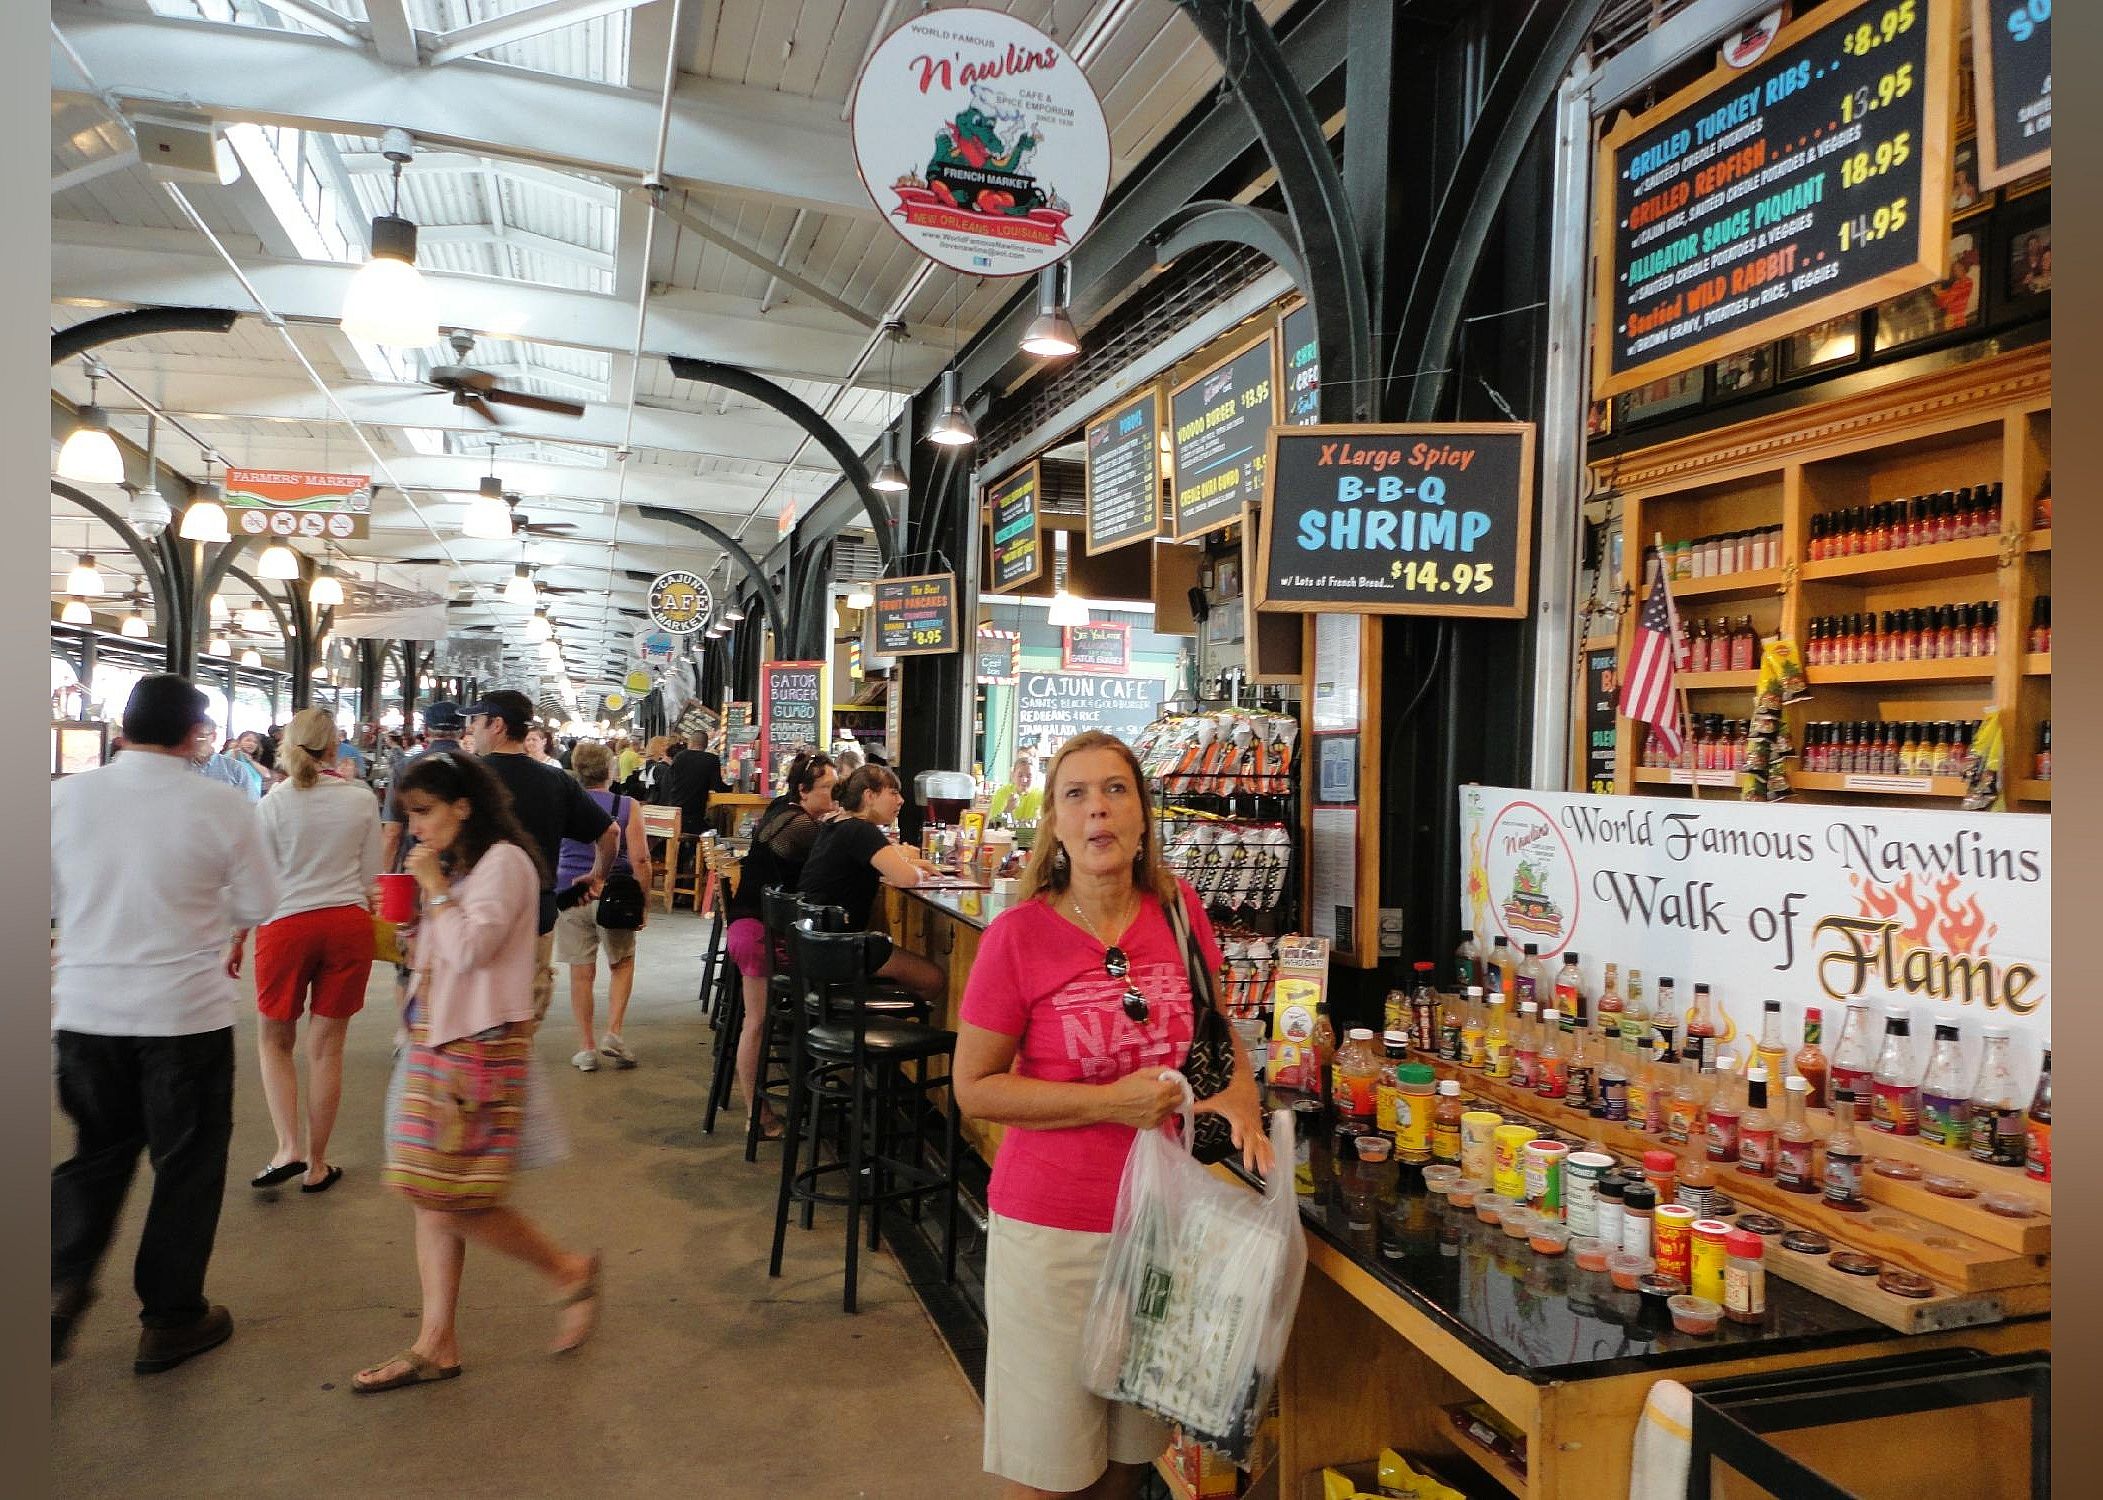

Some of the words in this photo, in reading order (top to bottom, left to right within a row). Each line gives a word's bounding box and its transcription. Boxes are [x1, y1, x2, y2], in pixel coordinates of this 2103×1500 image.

[911, 24, 950, 40] WORLD
[952, 32, 996, 48] FAMOUS
[1628, 127, 1692, 181] GRILLED
[1694, 86, 1761, 146] TURKEY
[1765, 58, 1811, 108] RIBS
[1842, 0, 1917, 58] $8.95
[1628, 180, 1691, 231] GRILLED
[1694, 137, 1767, 199] REDFISH
[1840, 62, 1913, 124] 13.95
[943, 166, 986, 184] FRENCH
[986, 174, 1030, 190] MARKET
[1628, 232, 1699, 288] ALLIGATOR
[1701, 207, 1751, 253] SAUCE
[1754, 171, 1826, 230] PIQUANT
[1840, 130, 1911, 190] 18.95
[914, 212, 938, 224] NEW
[940, 215, 990, 235] ORLEANS
[1685, 275, 1728, 314] WILD
[1730, 243, 1799, 297] RABBIT
[1838, 196, 1909, 253] 14.95
[1790, 260, 1840, 293] VEGGIES
[1205, 398, 1236, 430] BURGER
[1317, 443, 1339, 467] X
[1339, 442, 1402, 472] Large
[1407, 442, 1477, 472] Spicy
[304, 474, 366, 488] MARKET
[1337, 475, 1447, 506] B-B-Q
[1295, 507, 1493, 553] SHRIMP
[658, 573, 702, 591] CAJUN
[1280, 575, 1293, 587] w/
[1294, 575, 1314, 587] Lots
[1315, 576, 1327, 587] of
[1328, 576, 1357, 588] French
[1390, 559, 1495, 595] $14.95
[649, 592, 709, 612] CAFE
[655, 609, 704, 631] MARKET
[912, 629, 942, 646] $8.95
[769, 673, 817, 689] GATOR
[769, 688, 819, 701] BURGER
[1027, 675, 1094, 698] CAJUN
[773, 704, 816, 719] GUMBO
[1079, 711, 1101, 721] RICE
[1561, 803, 1655, 849] World
[1661, 811, 1816, 863] Famous
[1825, 821, 2043, 884] Nawlins
[1593, 868, 1731, 936] Walk
[1748, 891, 1808, 972] of
[1810, 912, 2047, 1017] Flame
